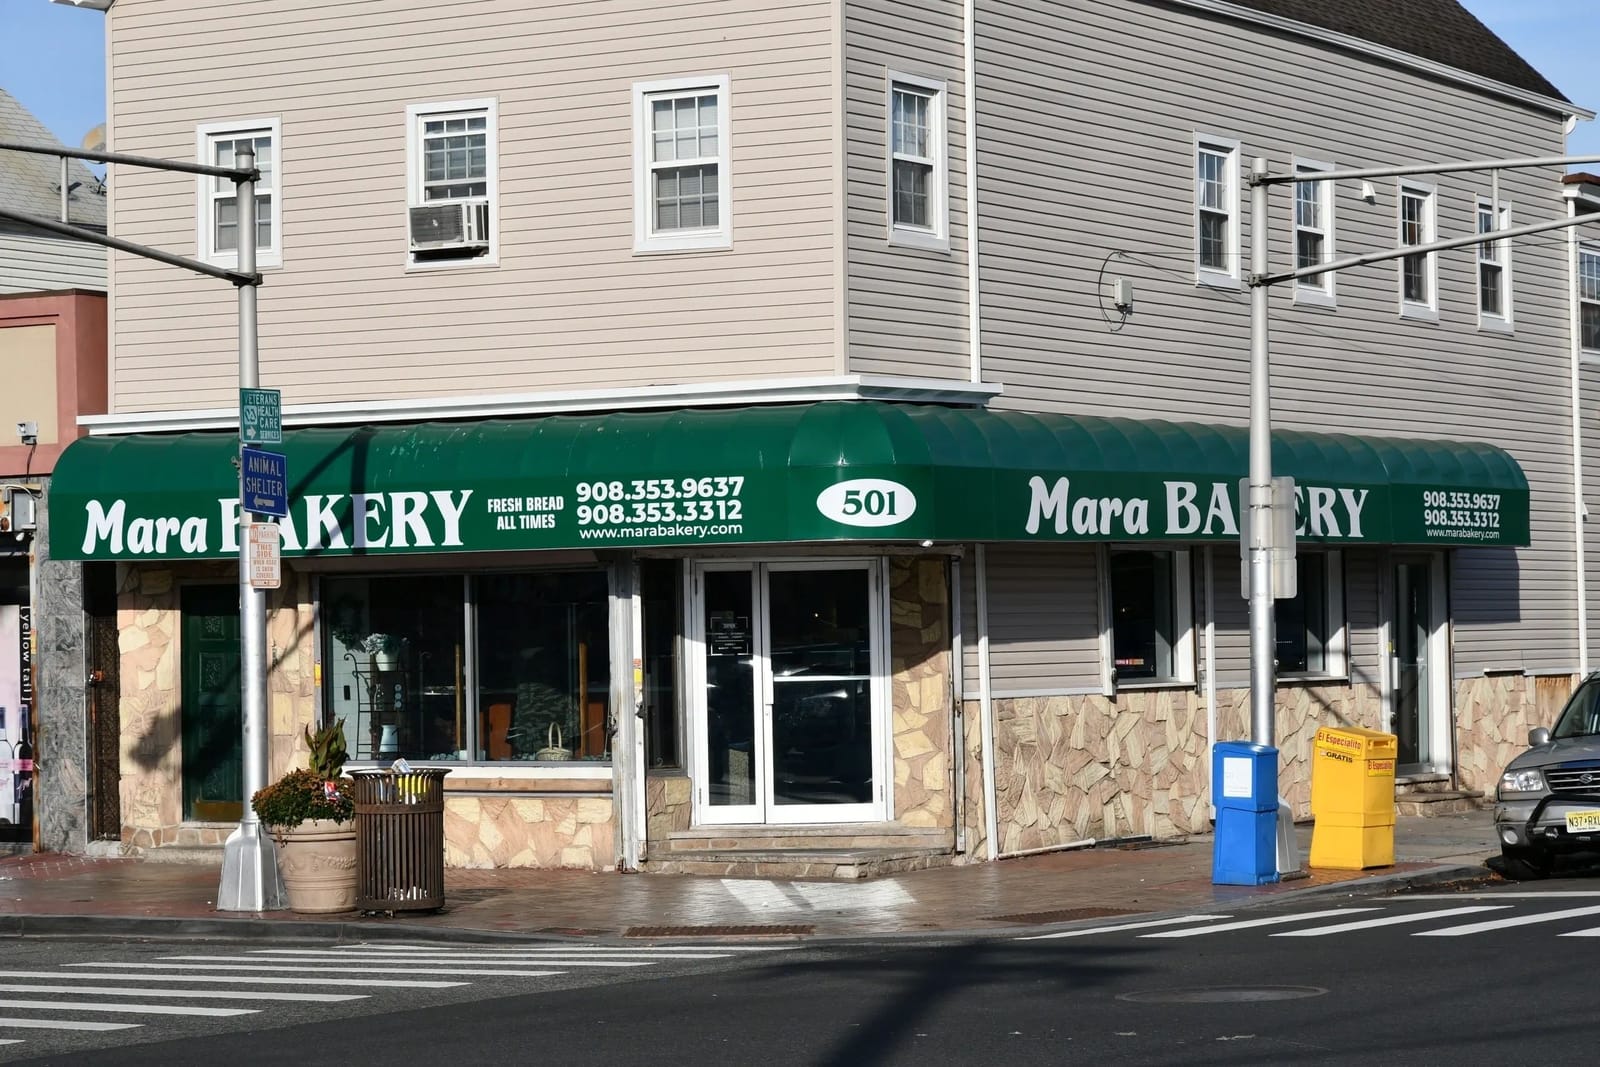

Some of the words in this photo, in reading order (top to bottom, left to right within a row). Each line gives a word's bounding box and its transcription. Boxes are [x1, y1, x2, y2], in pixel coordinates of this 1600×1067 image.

[243, 394, 277, 405] VETERANS
[258, 406, 278, 416] HEALTH
[260, 417, 278, 429] CARE
[249, 456, 282, 477] ANIMAL
[246, 476, 283, 497] SHELTER
[576, 476, 745, 502] 908.353.9637
[487, 498, 523, 513] FRESH
[526, 496, 564, 511] BREAD
[842, 490, 897, 516] 501
[1025, 475, 1149, 535] Mara
[1163, 481, 1369, 538] BARY
[1423, 491, 1501, 510] 908.353.9637
[577, 499, 743, 525] 908.353.3312
[1424, 509, 1500, 528] 908.353.3312
[81, 499, 208, 555] Mara
[496, 515, 516, 530] ALL
[518, 513, 556, 529] TIMES
[579, 522, 743, 539] www.marabakery.com
[1426, 528, 1500, 541] www.marabakery.com
[1318, 732, 1325, 741] El
[1326, 734, 1361, 750] Especialito
[1326, 752, 1353, 763] GRATIS
